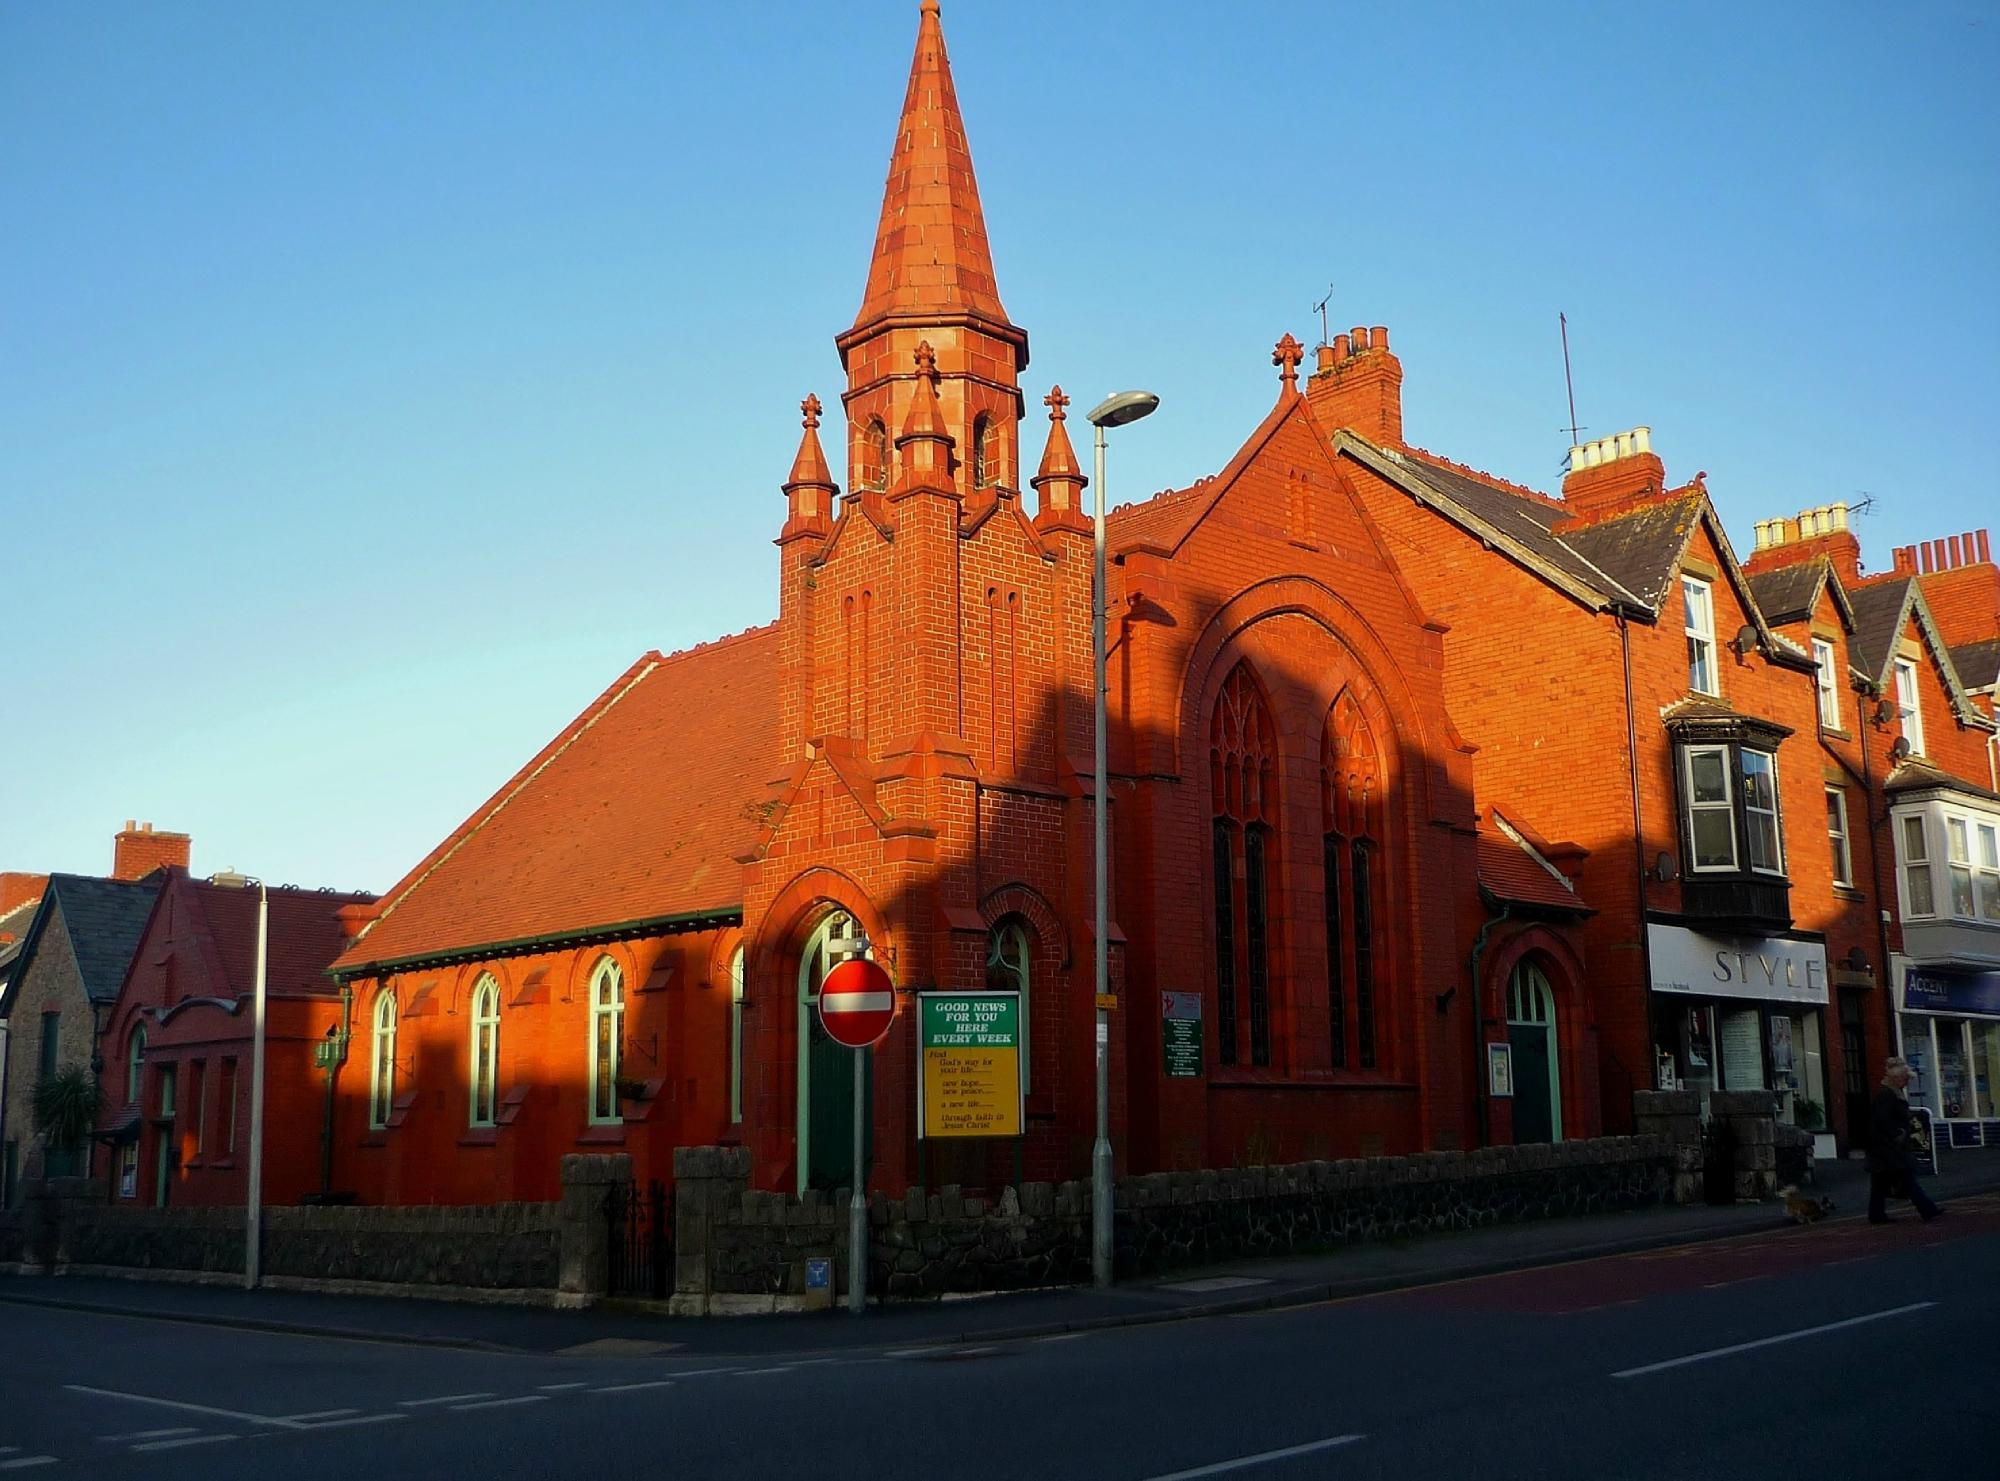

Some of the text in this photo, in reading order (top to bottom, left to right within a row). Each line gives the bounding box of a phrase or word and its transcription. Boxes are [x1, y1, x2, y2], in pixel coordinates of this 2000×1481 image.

[1713, 951, 1821, 990] STYLE
[936, 1002, 1007, 1012] GOOD NEWS
[945, 1012, 998, 1022] FOR YOU
[955, 1023, 989, 1033] HERE
[933, 1033, 1012, 1043] EVERY WEEK
[939, 1057, 993, 1067] God's way for
[941, 1112, 1004, 1122] through faith in
[942, 1121, 991, 1129] Jesus Christ
